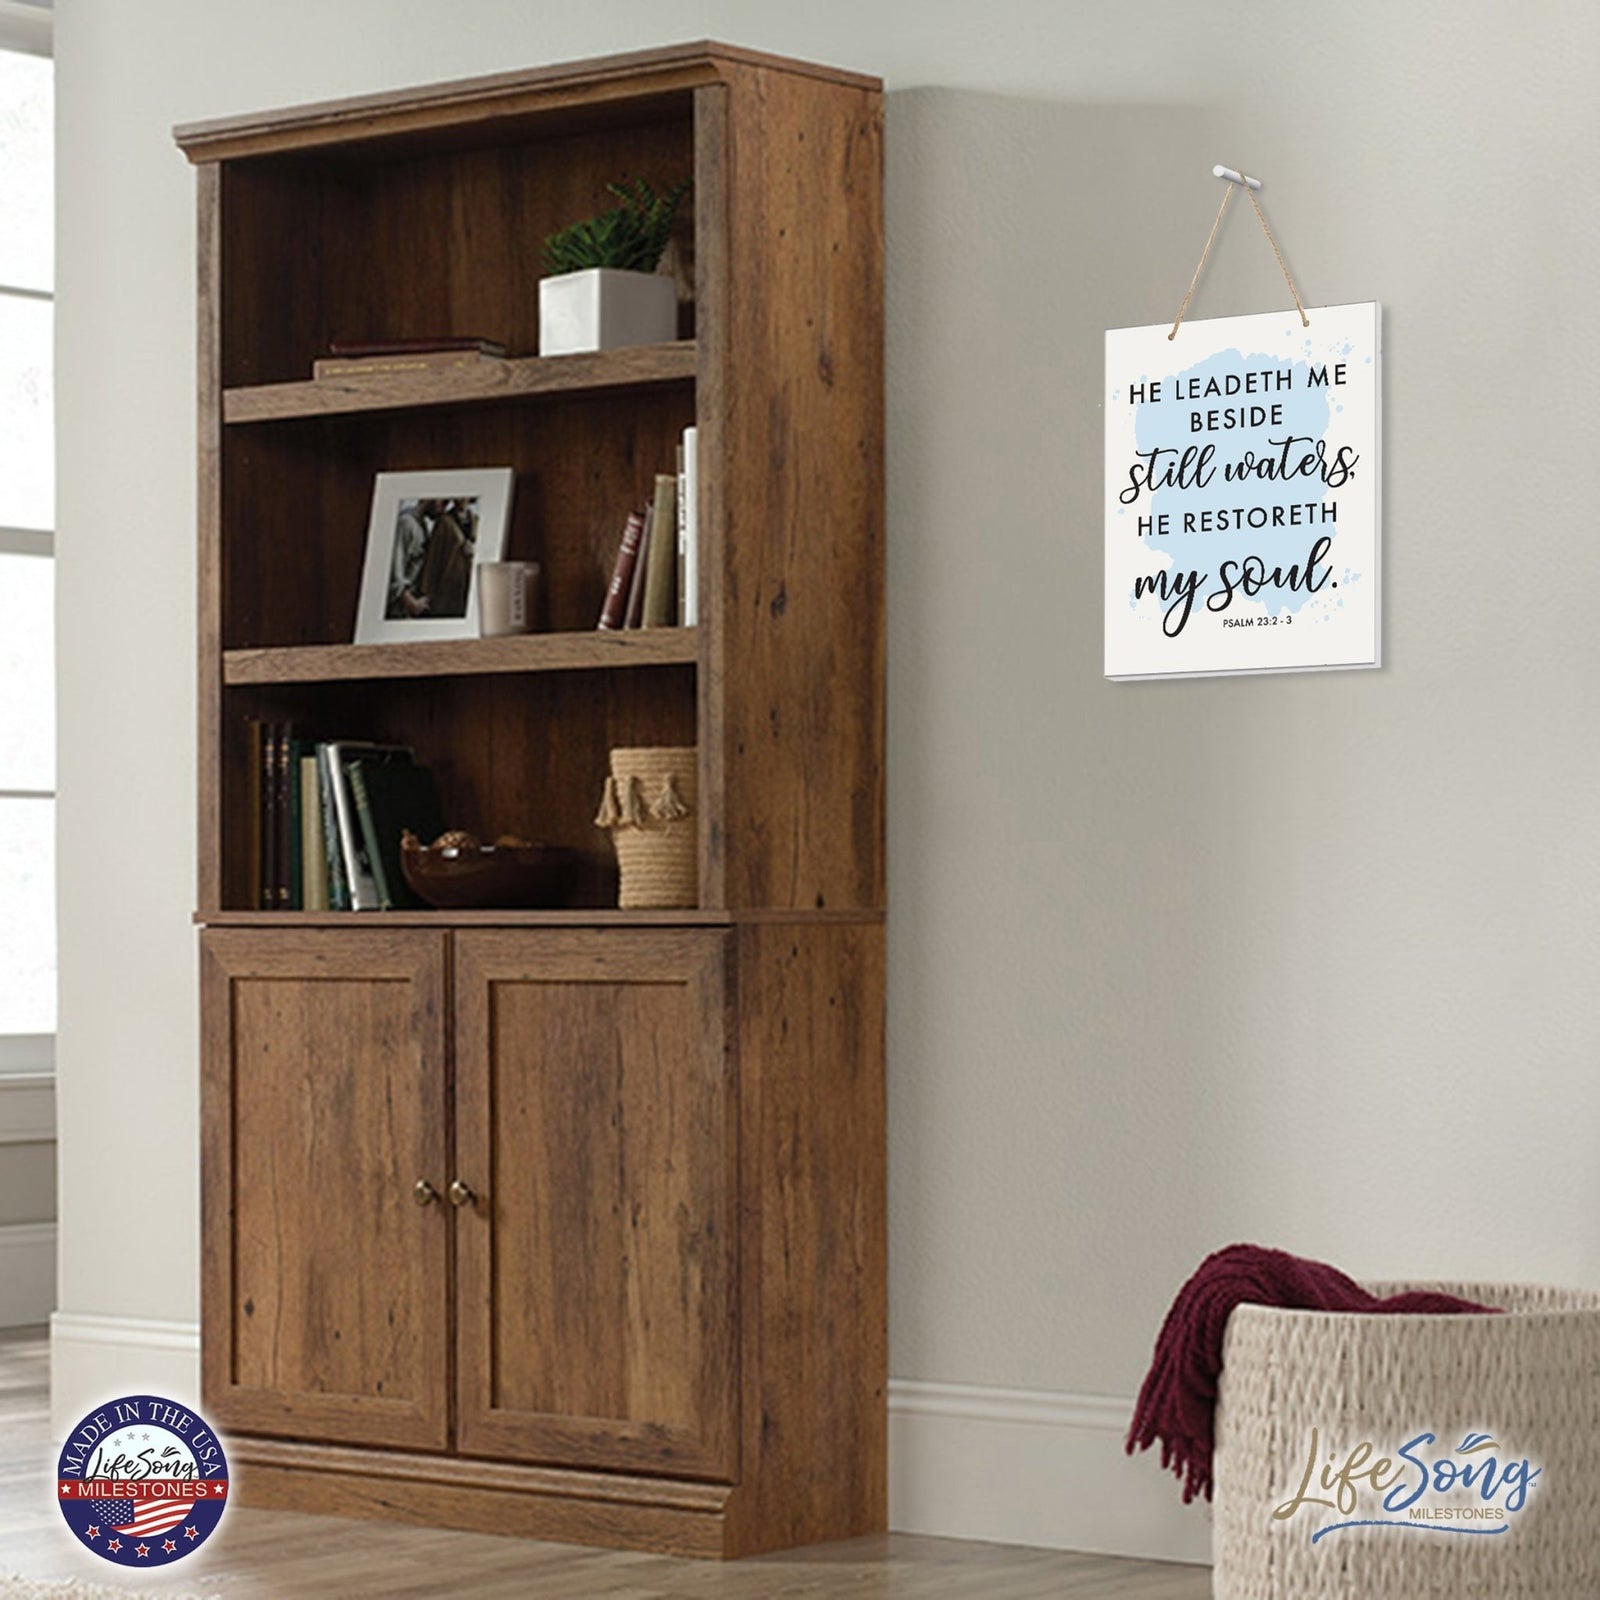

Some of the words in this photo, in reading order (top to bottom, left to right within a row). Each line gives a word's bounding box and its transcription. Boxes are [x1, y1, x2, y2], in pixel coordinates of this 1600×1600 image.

[1129, 380, 1161, 405] HE
[1176, 367, 1292, 401] LEADETH
[1307, 362, 1347, 388] ME
[1190, 402, 1283, 433] BESIDE
[1119, 443, 1217, 505] still
[1224, 434, 1360, 488] waters,
[1138, 513, 1170, 537] HE
[1184, 500, 1337, 534] RESTORETH
[1134, 568, 1209, 638] my
[1206, 535, 1338, 613] soul.
[1223, 617, 1255, 629] PSALM
[1257, 615, 1279, 627] 23:2
[1286, 614, 1293, 626] 3
